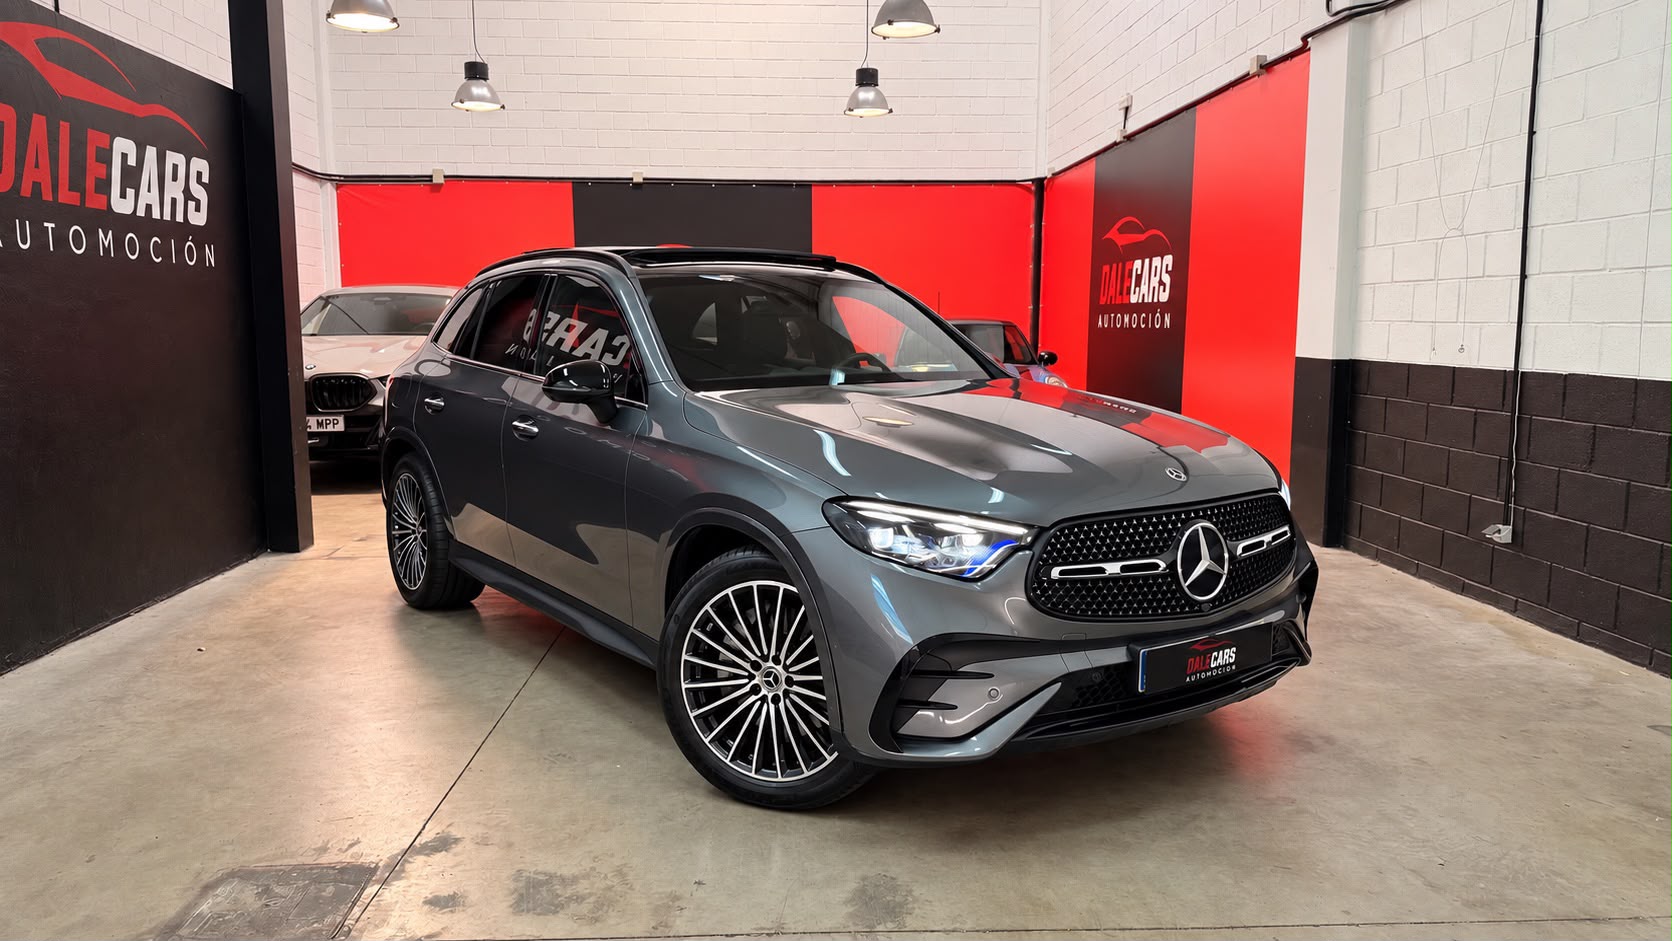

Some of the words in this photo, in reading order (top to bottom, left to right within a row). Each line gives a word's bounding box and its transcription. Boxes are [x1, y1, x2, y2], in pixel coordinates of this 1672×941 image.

[0, 219, 215, 268] UTOMOCIÓN
[1099, 254, 1174, 305] DALECARS
[1097, 308, 1171, 329] AUTOMOCIÓN
[316, 418, 340, 430] MPP
[1186, 647, 1236, 675] DALECARS
